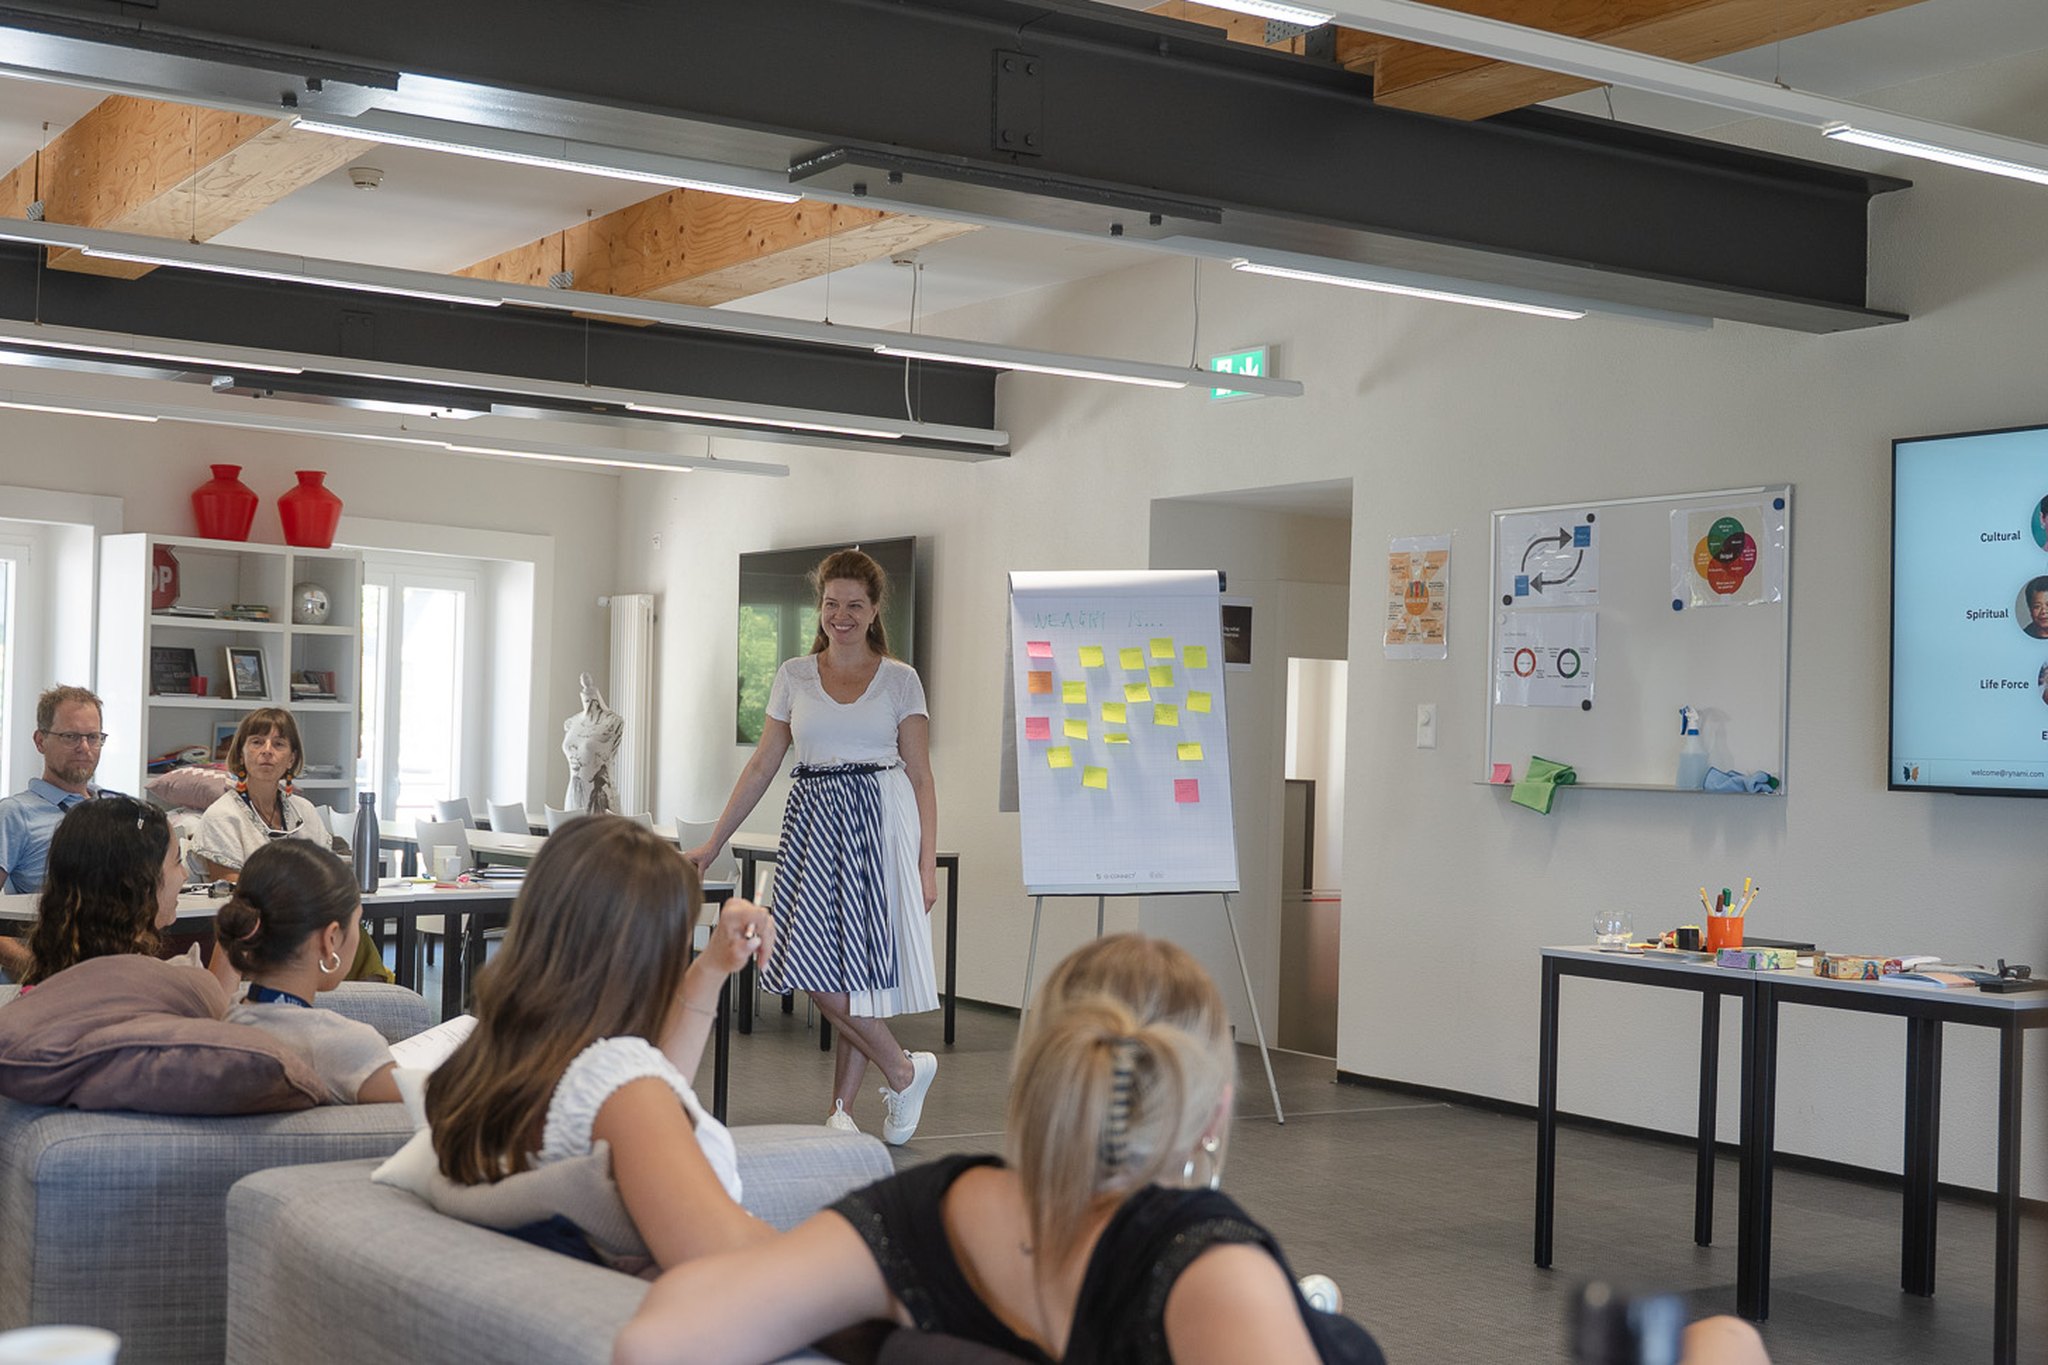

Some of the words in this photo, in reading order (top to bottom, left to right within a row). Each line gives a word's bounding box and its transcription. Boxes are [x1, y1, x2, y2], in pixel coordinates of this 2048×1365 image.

[1980, 530, 2021, 543] Cultural
[1966, 608, 2009, 621] Spiritual
[1980, 679, 1999, 689] Life
[2001, 679, 2030, 689] Force
